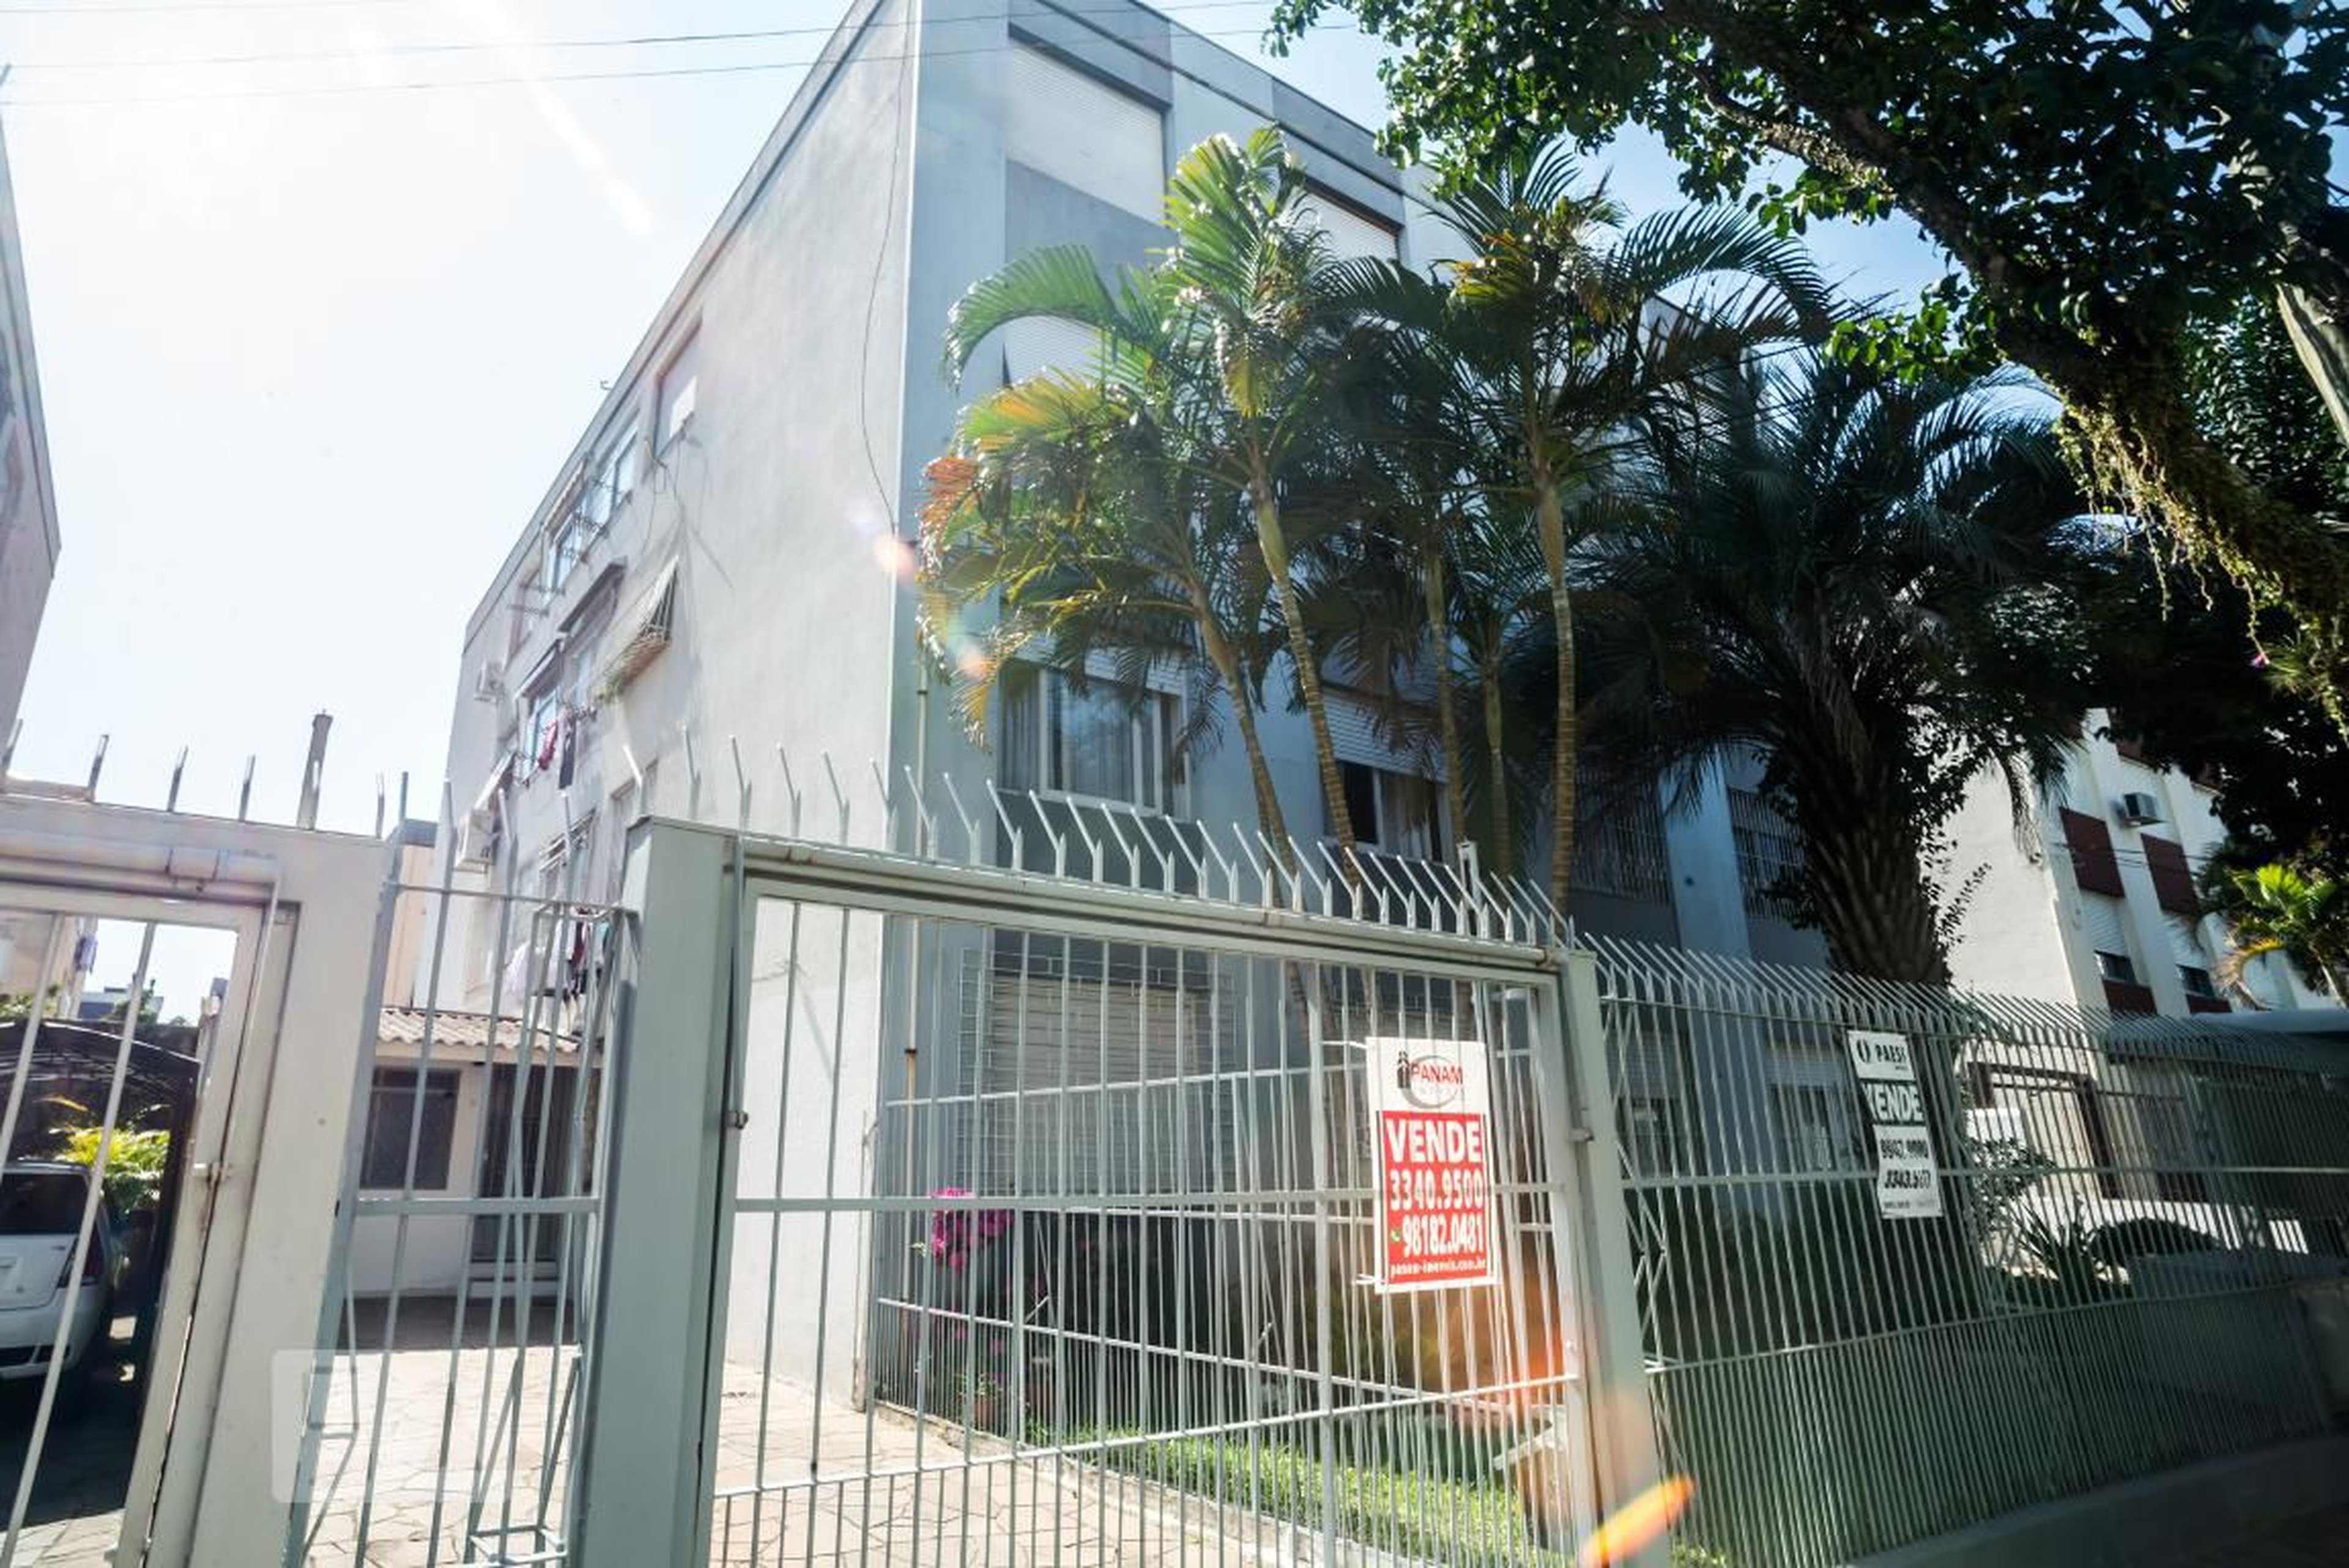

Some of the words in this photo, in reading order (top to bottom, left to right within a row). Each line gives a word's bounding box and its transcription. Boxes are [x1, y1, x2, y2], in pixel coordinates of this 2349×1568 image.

[1411, 1062, 1463, 1085] PANAM
[1860, 1082, 1924, 1122] VENDE
[1386, 1118, 1482, 1163] VENDE
[1389, 1167, 1483, 1211] 3340.9500
[1402, 1213, 1483, 1257] 98182.0481
